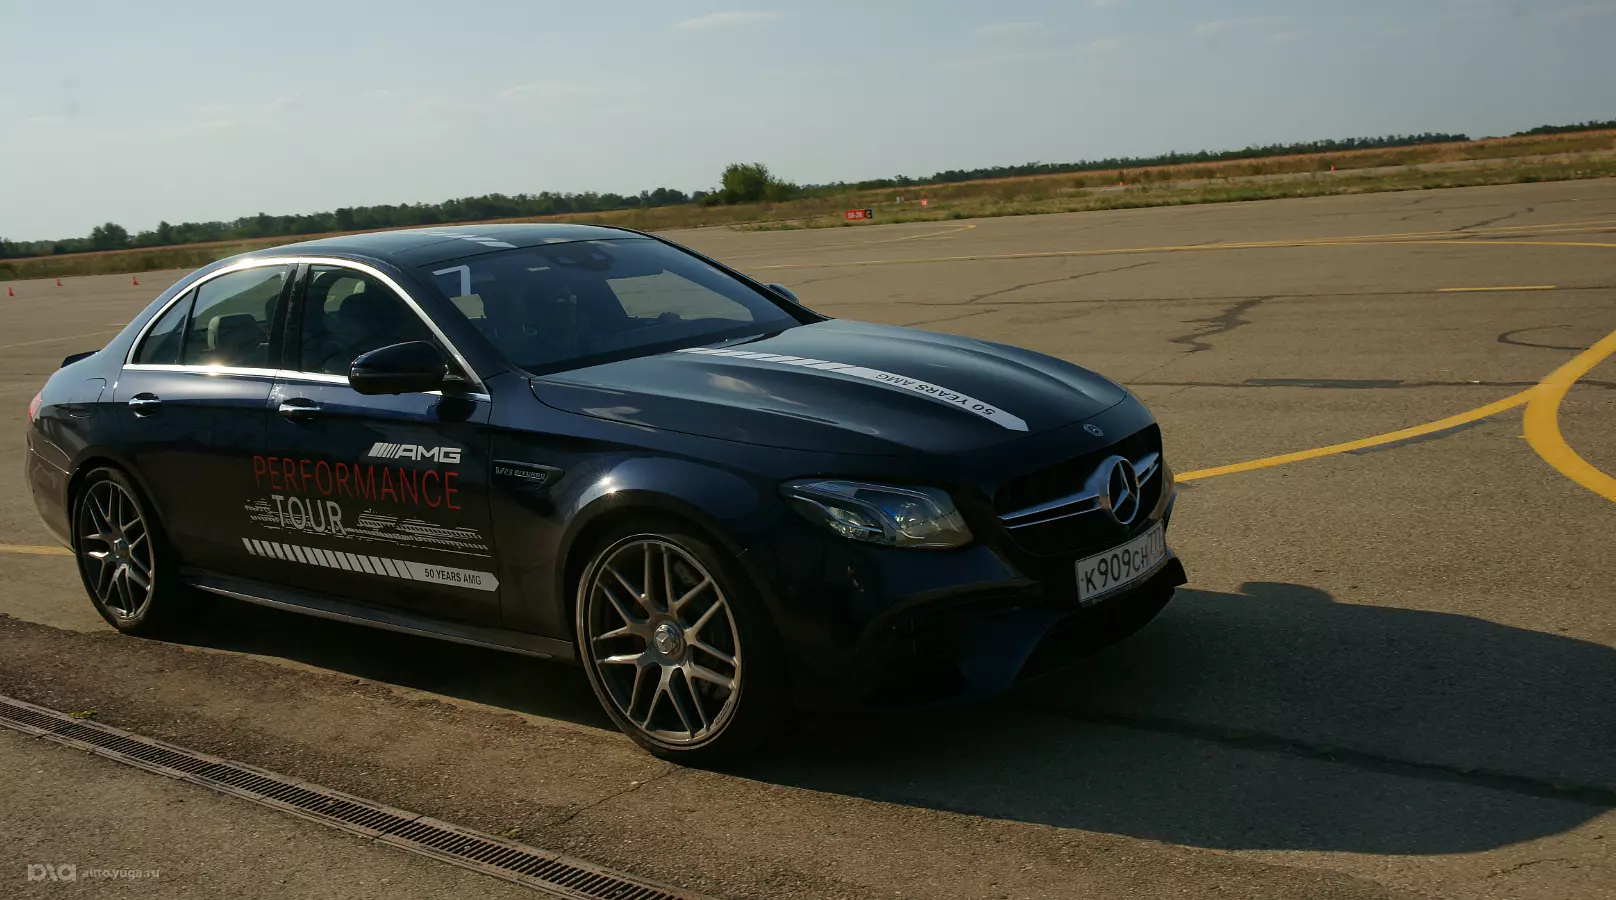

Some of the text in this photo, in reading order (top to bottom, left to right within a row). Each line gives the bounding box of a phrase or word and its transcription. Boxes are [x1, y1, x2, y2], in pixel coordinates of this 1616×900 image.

[875, 373, 996, 416] 50 YEARS AMG
[253, 455, 461, 510] PERFORMANCE
[271, 494, 347, 536] TOUR
[424, 568, 482, 585] 50 YEARS AMG
